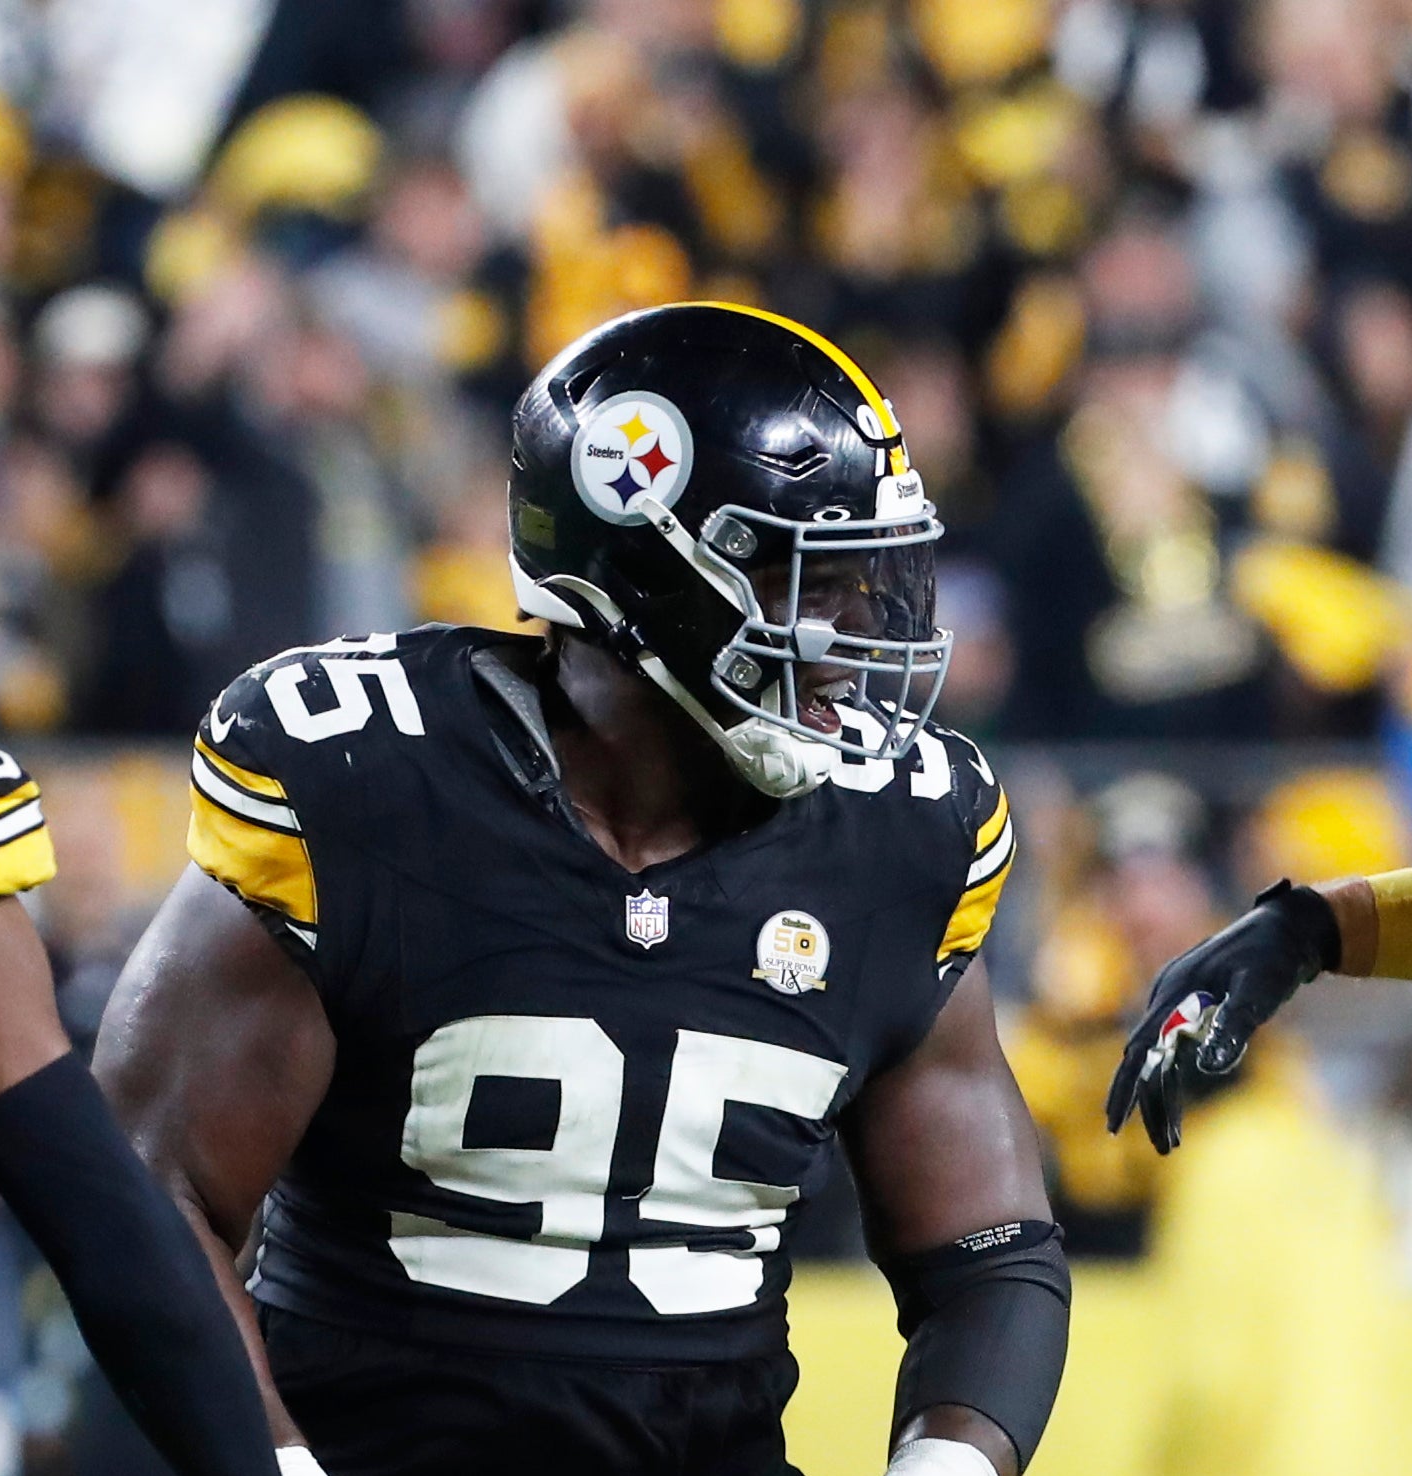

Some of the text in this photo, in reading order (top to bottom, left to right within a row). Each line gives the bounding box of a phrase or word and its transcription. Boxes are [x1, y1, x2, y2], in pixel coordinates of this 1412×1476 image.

[587, 443, 624, 460] Steelers
[633, 916, 662, 938] NFL
[773, 928, 817, 957] 50
[389, 1015, 849, 1316] 95
